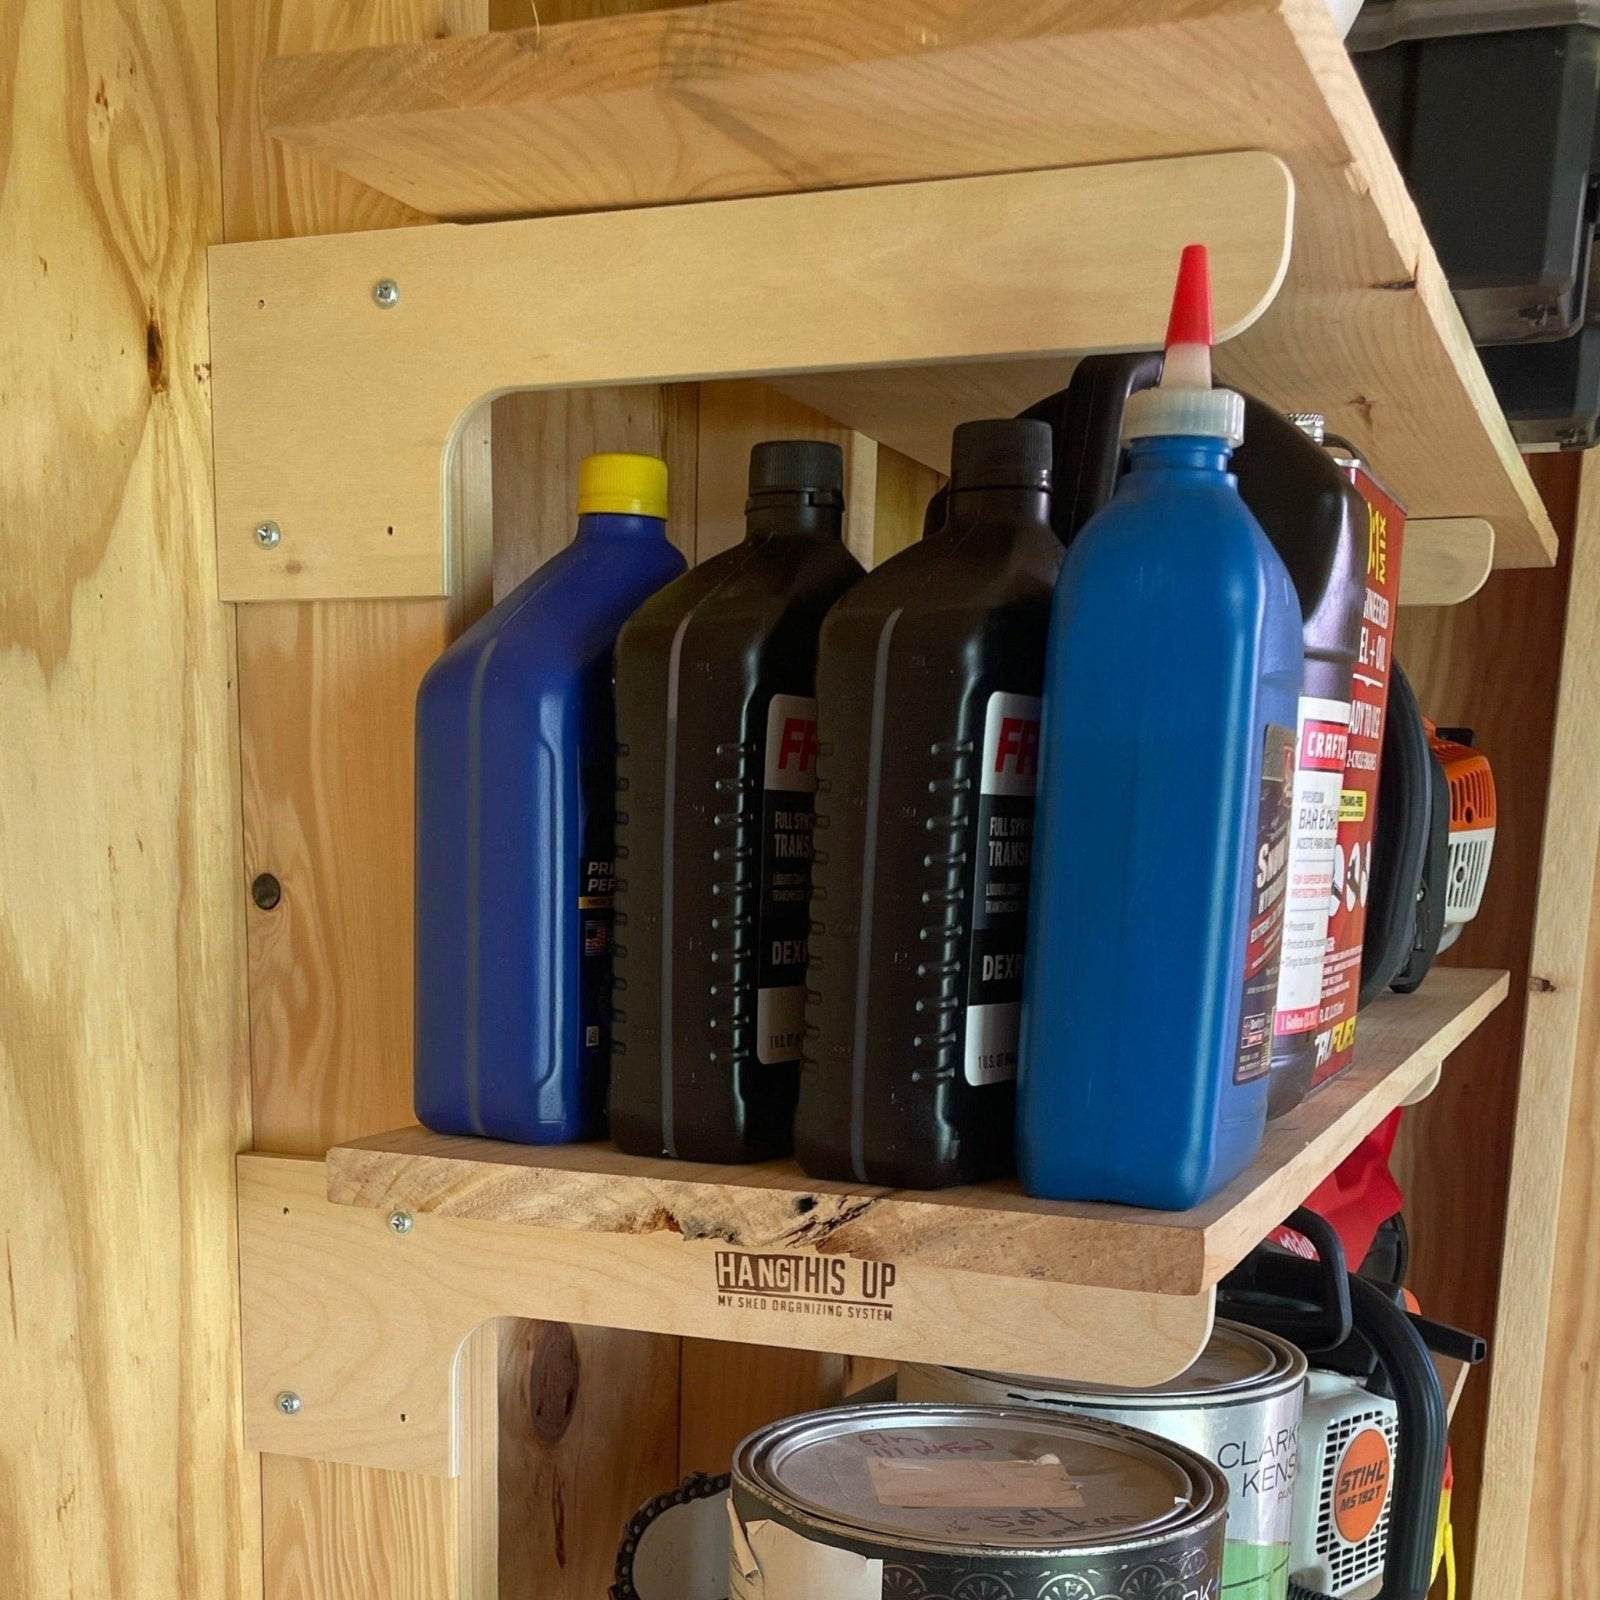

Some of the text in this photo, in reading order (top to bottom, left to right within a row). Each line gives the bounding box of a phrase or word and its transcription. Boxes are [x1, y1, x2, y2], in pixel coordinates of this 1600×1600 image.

[989, 816, 1009, 837] FULL
[1298, 808, 1318, 830] BAR
[862, 1261, 896, 1299] UP
[718, 1295, 893, 1321] MY SHED ORGANIZING SYSTEM
[1338, 1459, 1385, 1496] STIHL
[1339, 1493, 1357, 1513] MS
